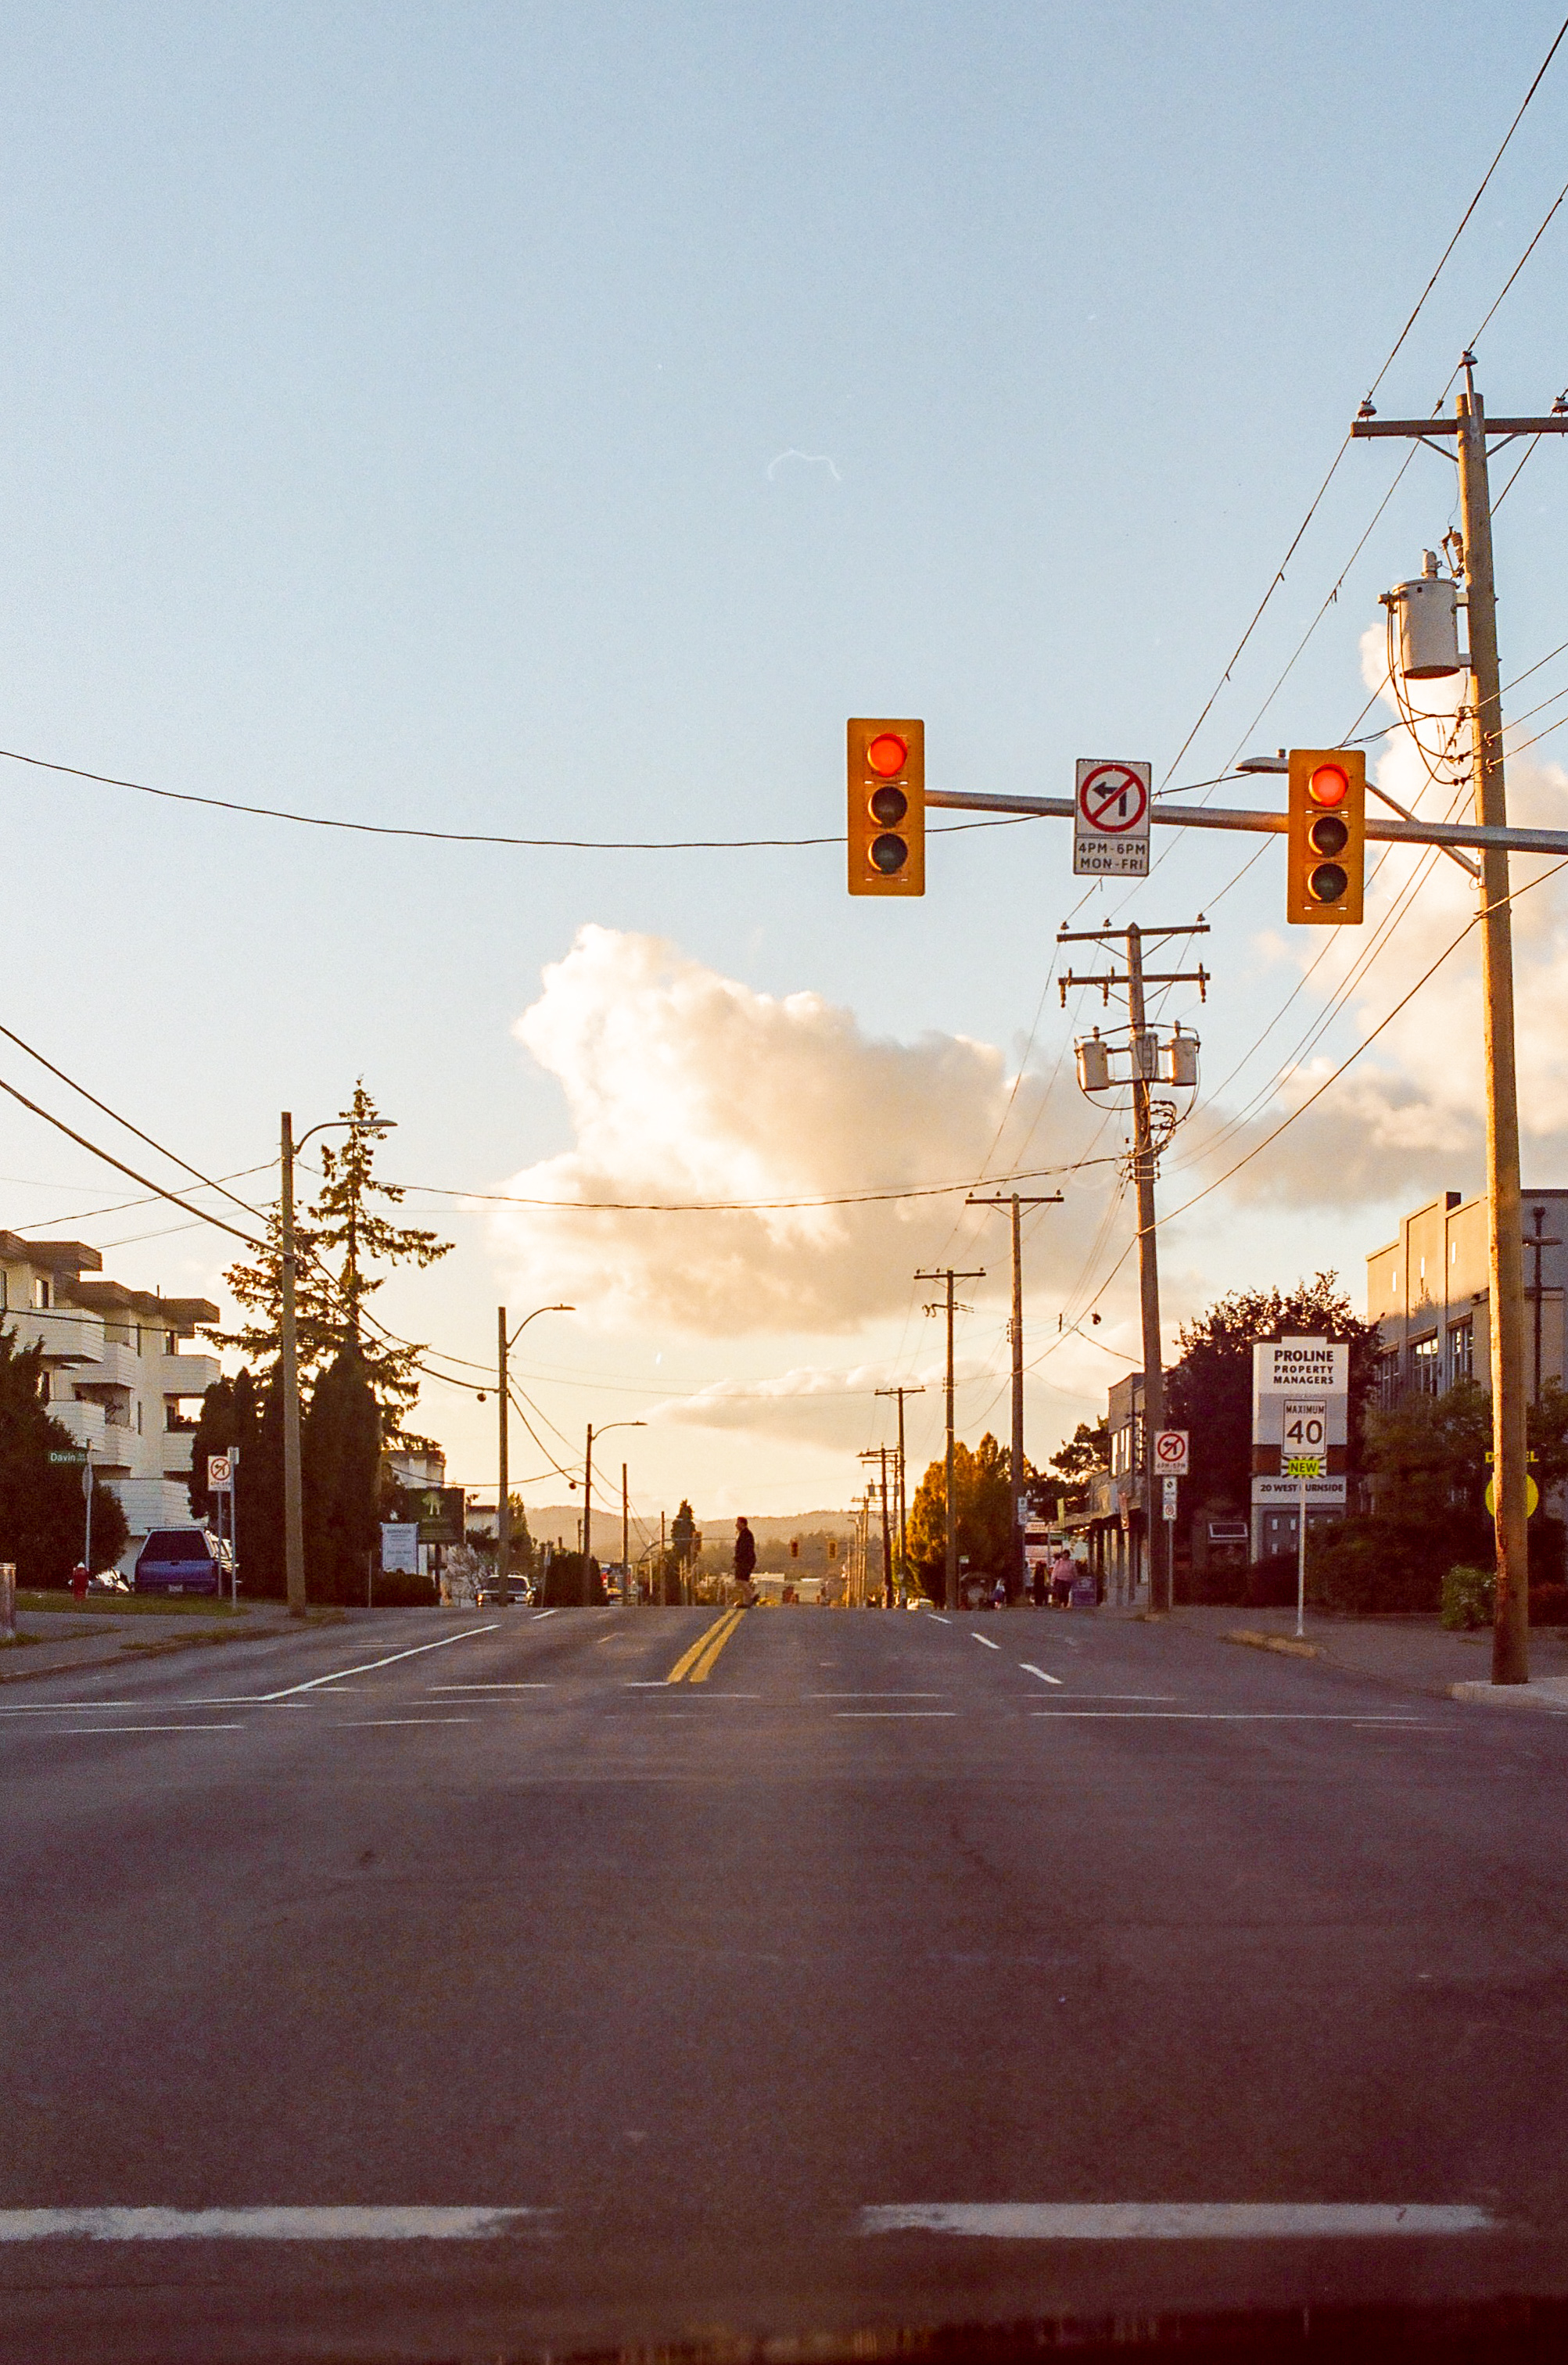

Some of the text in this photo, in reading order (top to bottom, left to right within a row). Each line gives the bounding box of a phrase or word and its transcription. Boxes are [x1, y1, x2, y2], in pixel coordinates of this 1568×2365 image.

[1274, 1350, 1333, 1362] PROLINE
[1274, 1365, 1333, 1373] PROPERTY
[1273, 1376, 1333, 1384] MANAGERS
[1286, 1405, 1324, 1414] MAXIMUM
[1286, 1419, 1322, 1444] 40
[50, 1452, 76, 1462] Davin
[1290, 1462, 1317, 1473] NEW
